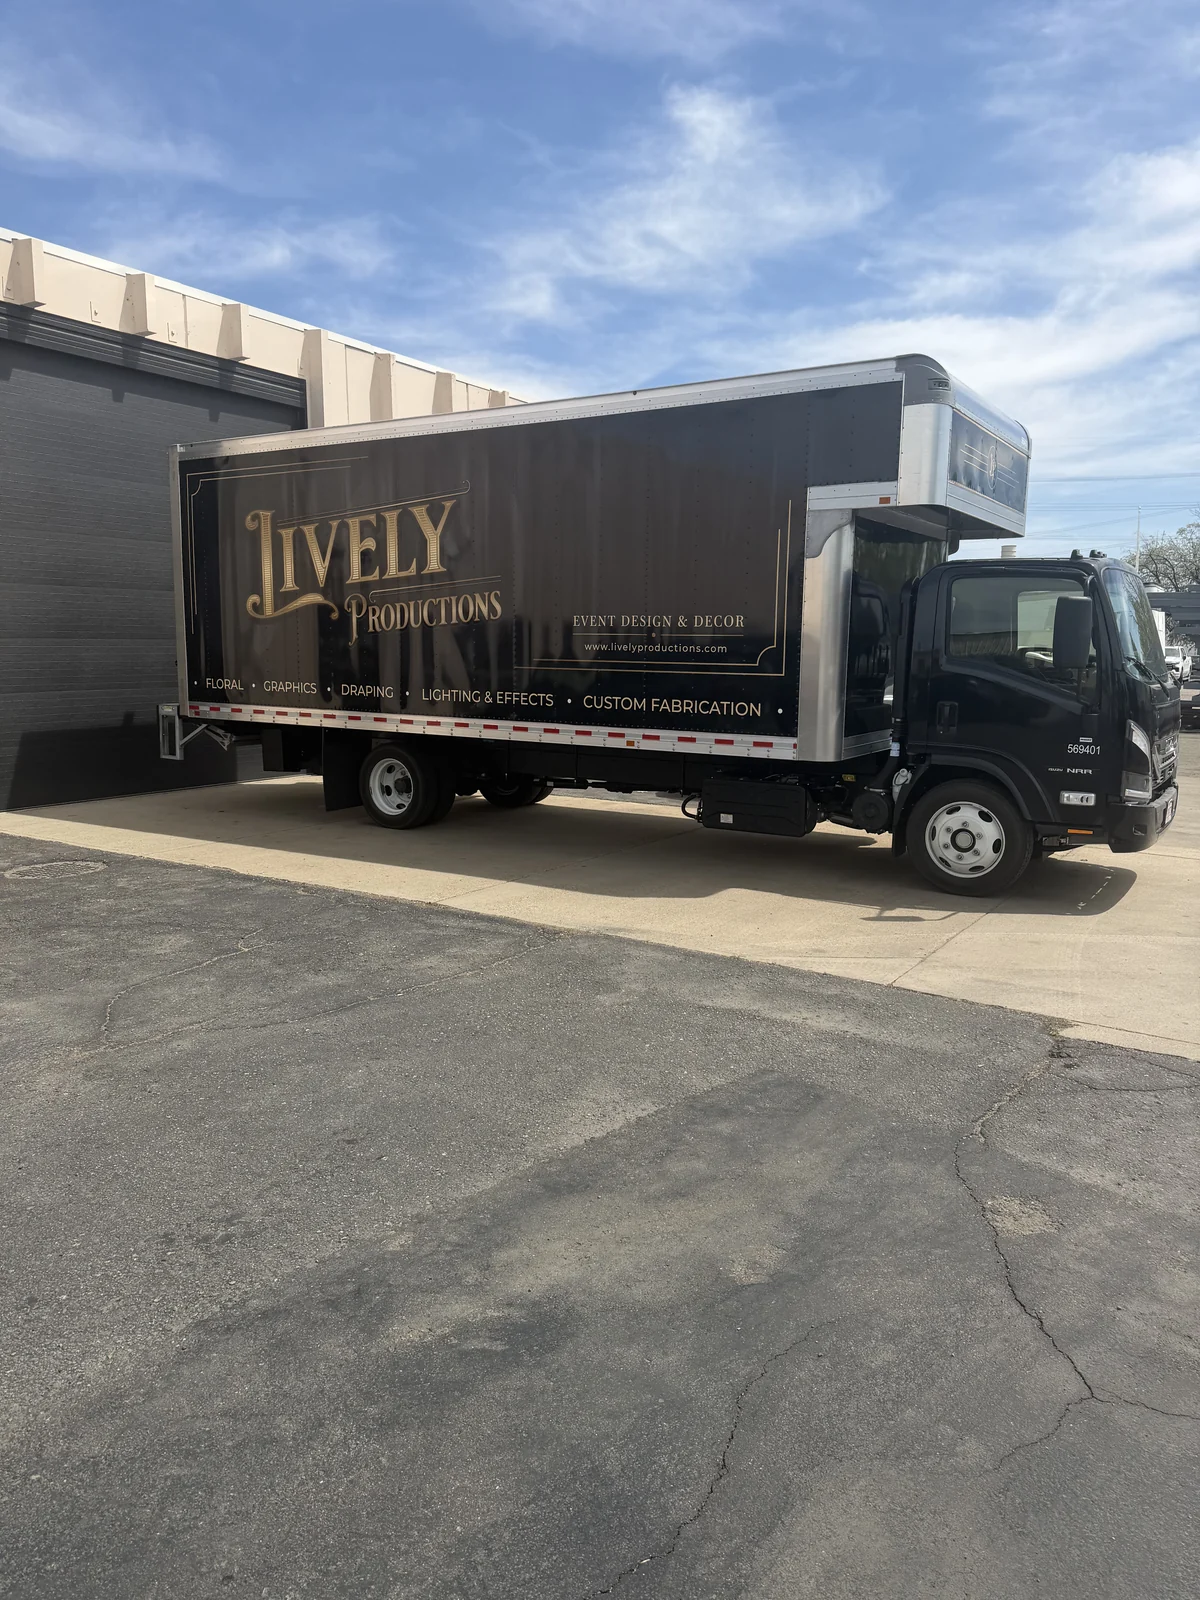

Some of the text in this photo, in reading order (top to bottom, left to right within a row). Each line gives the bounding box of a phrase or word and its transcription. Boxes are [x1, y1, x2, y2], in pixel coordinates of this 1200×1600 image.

[245, 500, 456, 619] LIVELY
[344, 590, 502, 647] PRODUCTIONS
[573, 615, 745, 628] EVENT DESIGN & DECOR
[584, 641, 728, 654] www.livelyproductions.com
[206, 678, 244, 691] FLORAL
[263, 680, 317, 694] GRAPHICS
[341, 684, 394, 698] DRAPING
[422, 688, 554, 707] LIGHTING & EFFECTS
[583, 695, 762, 717] CUSTOM FABRICATION
[1067, 743, 1101, 755] 569401
